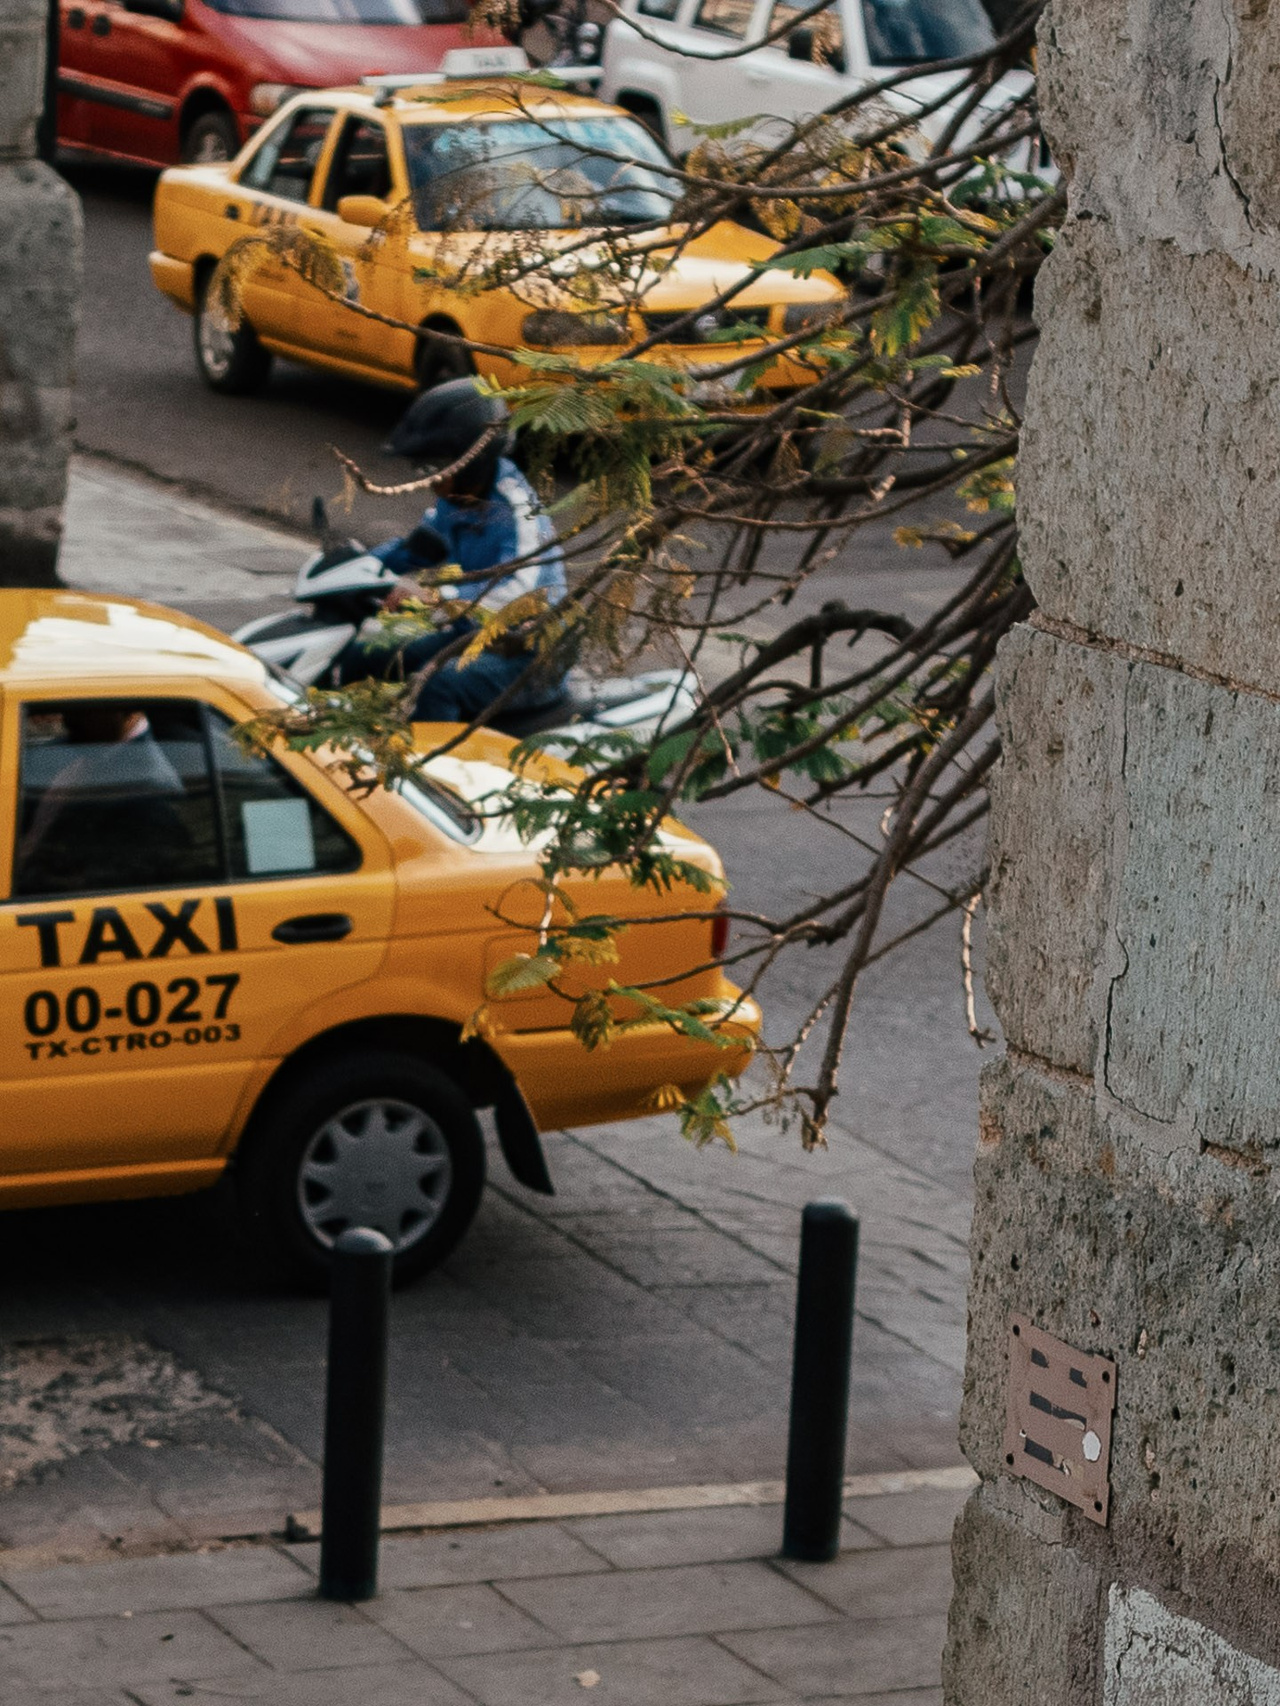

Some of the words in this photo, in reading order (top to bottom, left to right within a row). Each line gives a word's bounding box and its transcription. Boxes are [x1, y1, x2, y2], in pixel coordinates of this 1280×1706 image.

[16, 896, 239, 967] TAXI
[23, 973, 241, 1037] 00-027
[24, 1023, 242, 1061] TX-CTRO-003
